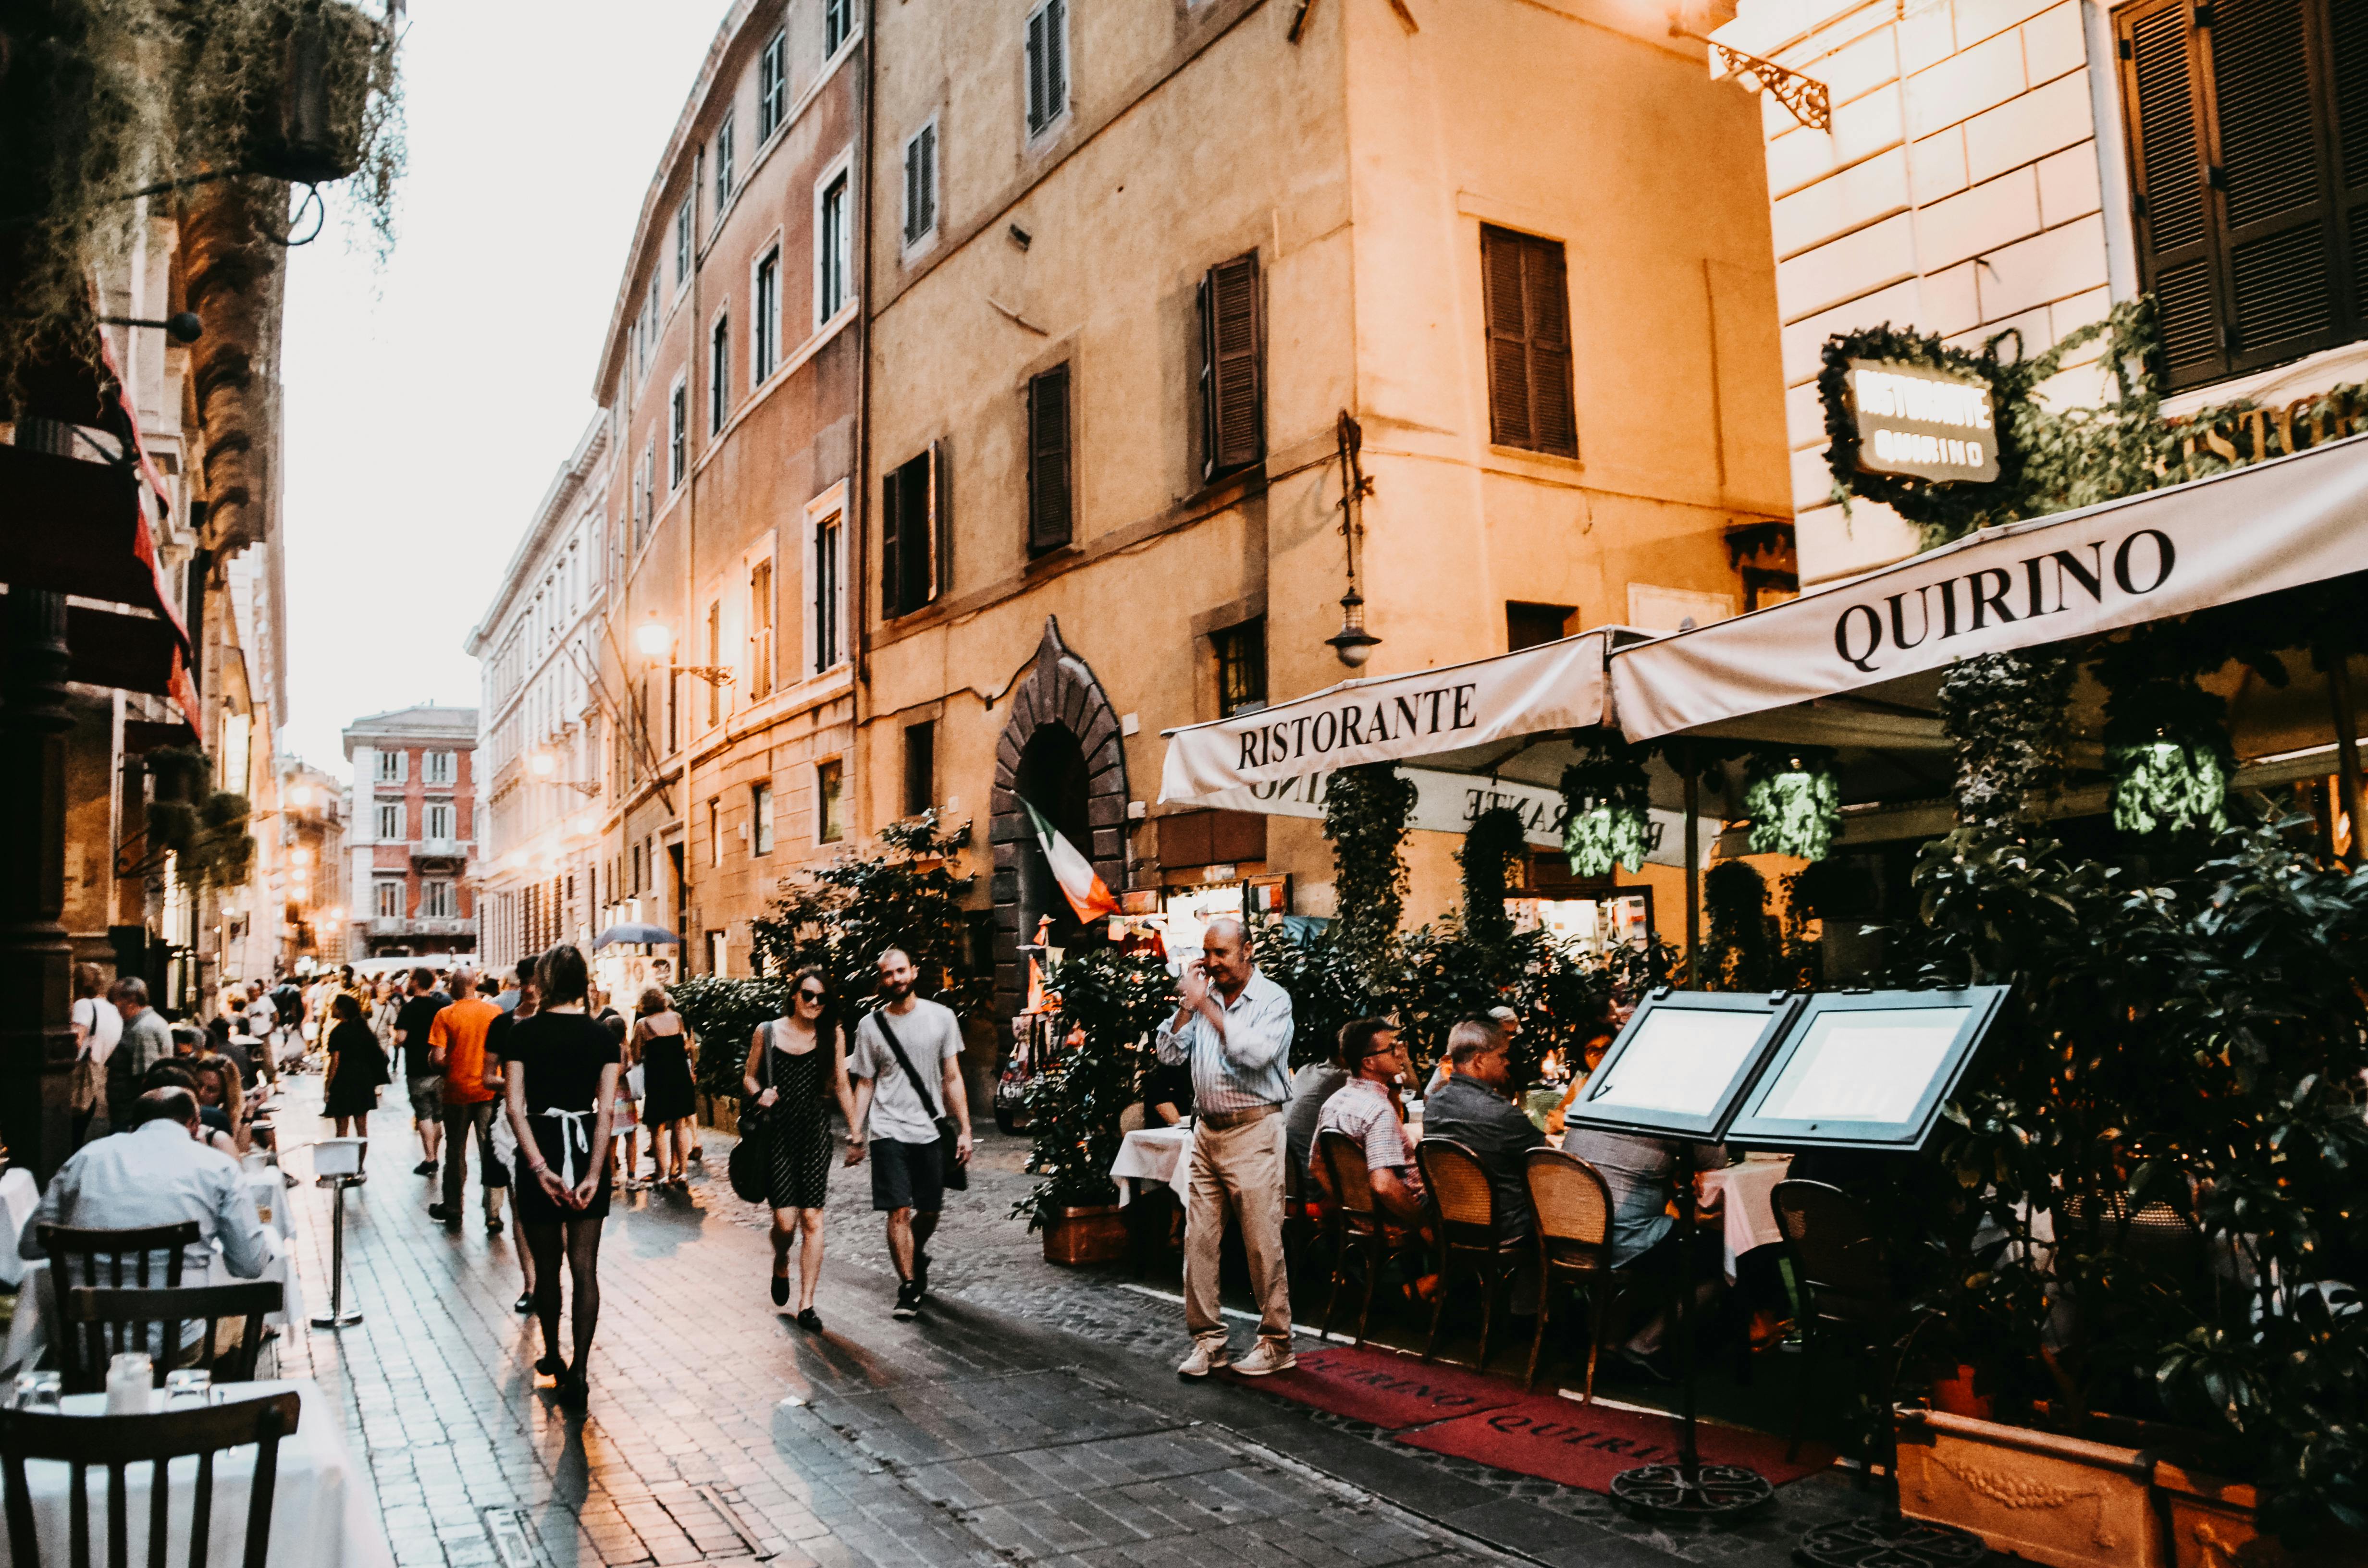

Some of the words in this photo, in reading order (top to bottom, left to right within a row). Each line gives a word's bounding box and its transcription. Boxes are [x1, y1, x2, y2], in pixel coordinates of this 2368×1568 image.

[1875, 429, 1984, 467] QUIRINO
[1835, 529, 2175, 673] QUIRINO
[1237, 683, 1477, 770] RISTORANTE
